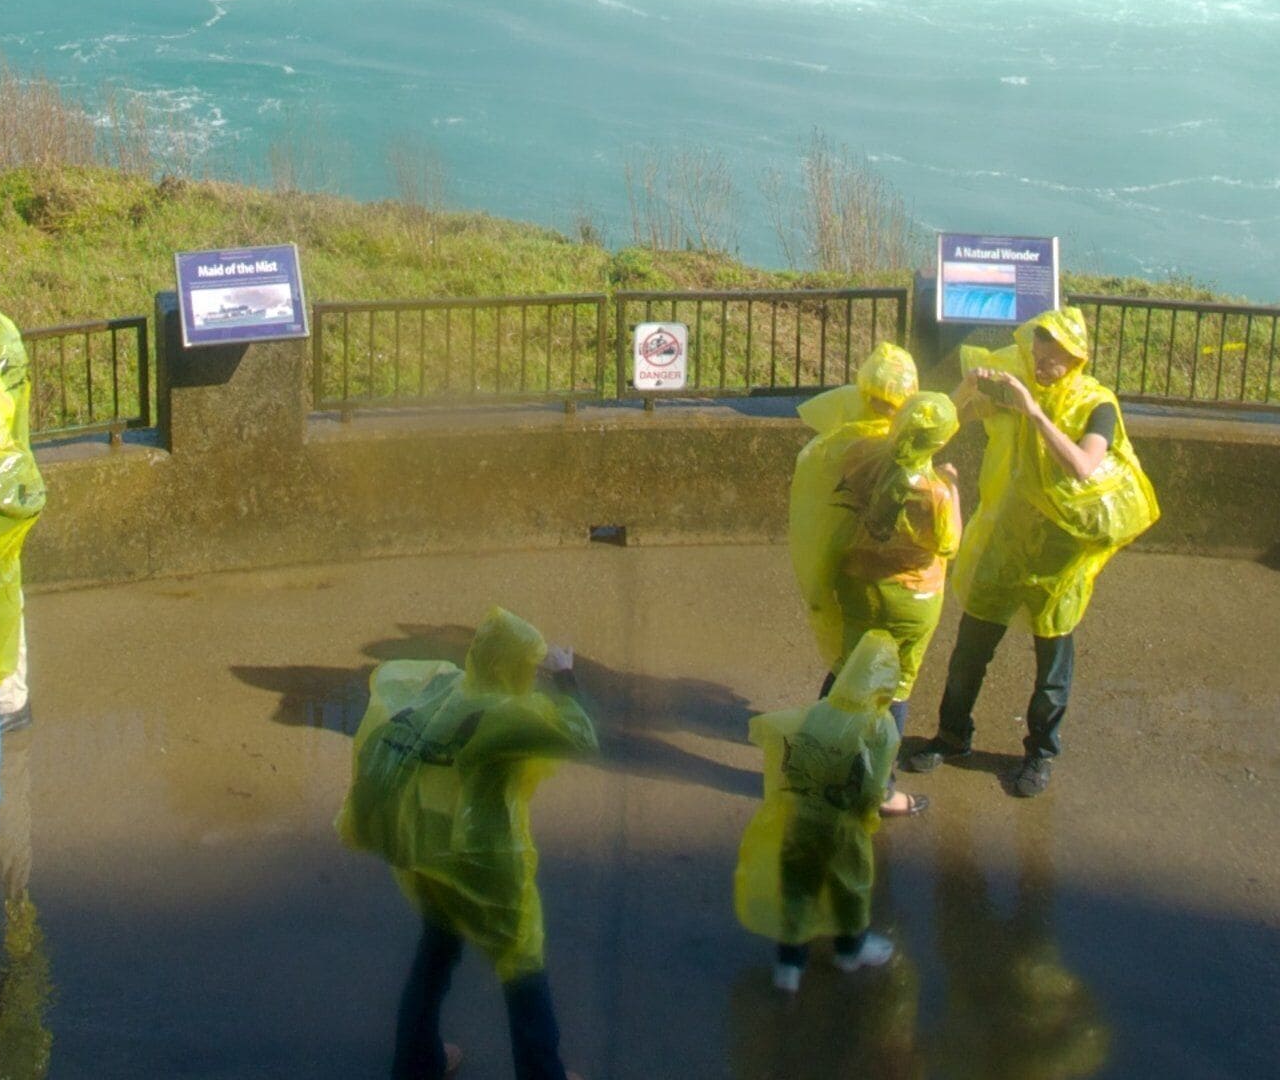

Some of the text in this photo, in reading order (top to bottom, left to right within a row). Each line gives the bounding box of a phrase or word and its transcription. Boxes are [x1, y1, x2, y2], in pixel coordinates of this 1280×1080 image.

[955, 246, 1040, 261] A Natural Wonder
[198, 260, 277, 277] Maid of the Mist
[639, 371, 681, 379] DANGER
